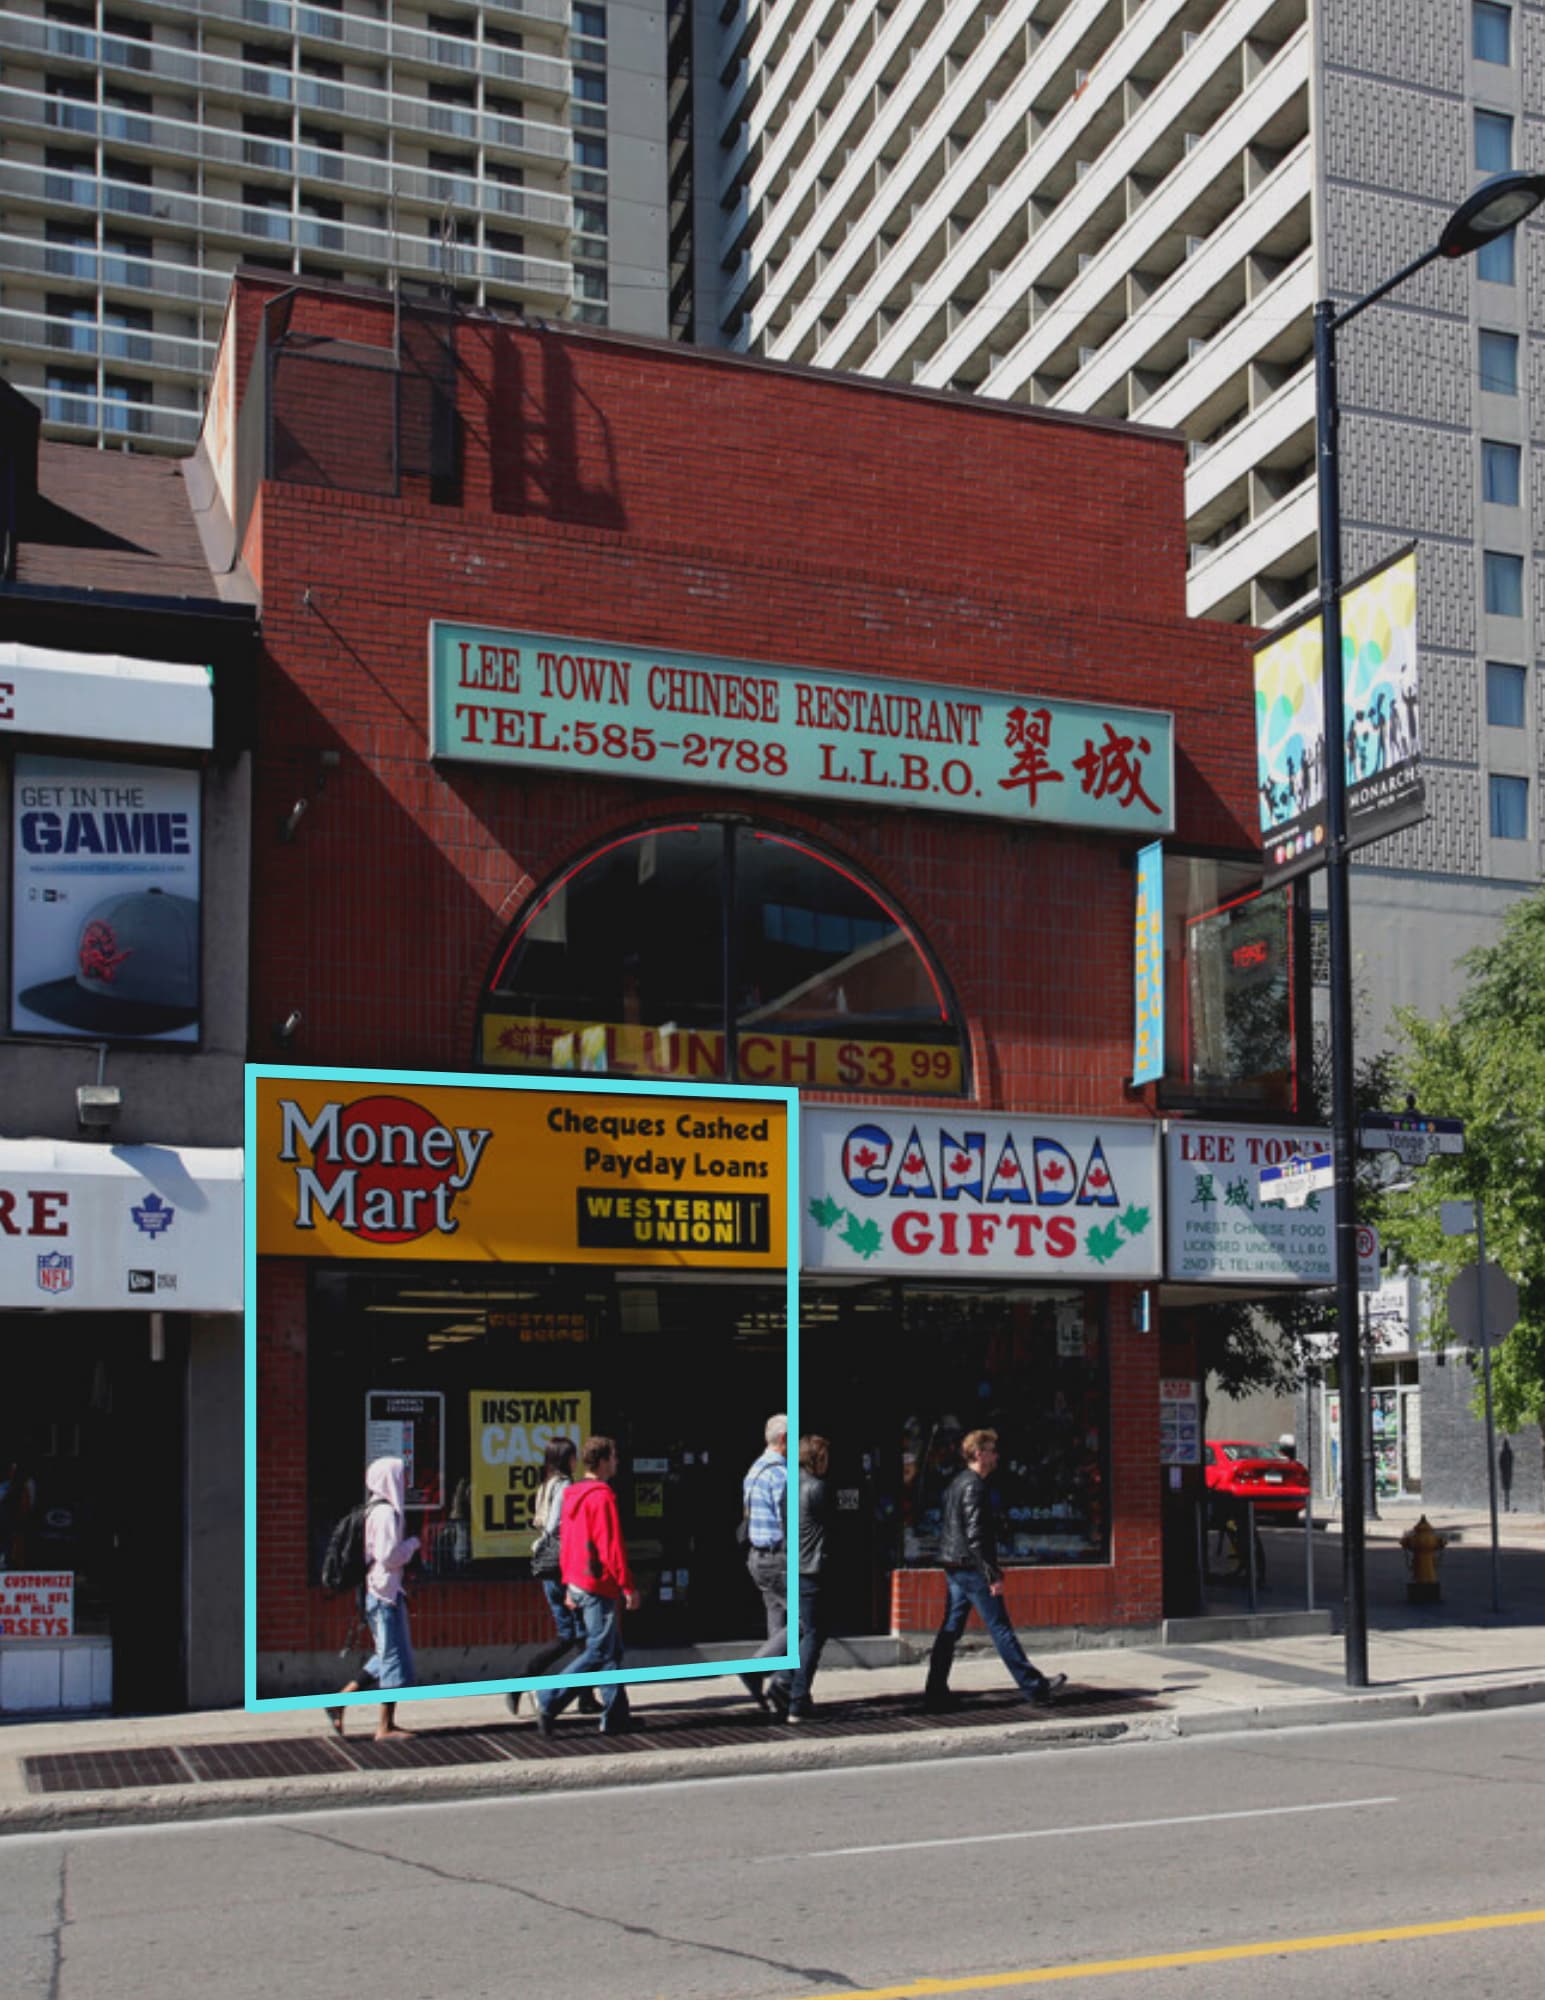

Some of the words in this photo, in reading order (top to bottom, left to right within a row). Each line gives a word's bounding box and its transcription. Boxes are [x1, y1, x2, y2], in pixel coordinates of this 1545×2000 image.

[458, 642, 520, 694] LEE
[536, 652, 632, 706] TOWN
[647, 665, 779, 724] CHINESE
[794, 683, 983, 747] RESTAURANT
[456, 704, 788, 777] TEL:585-2788
[818, 744, 982, 797] L.L.B.O.
[20, 786, 64, 808] GET
[71, 787, 96, 808] IN
[100, 788, 145, 809] THE
[1351, 763, 1422, 806] MONARCHS
[20, 811, 191, 855] GAME
[606, 1026, 817, 1083] LUNCH
[836, 1042, 953, 1088] $3.99
[547, 1107, 666, 1140] Cheques
[676, 1114, 769, 1141] Cashed
[277, 1099, 494, 1191] Money
[1180, 1133, 1235, 1164] LEE
[584, 1147, 686, 1180] Payday
[694, 1152, 769, 1178] Loans
[841, 1123, 1120, 1208] CANADA
[293, 1166, 460, 1234] Mart
[586, 1195, 734, 1221] WESTERN
[634, 1220, 734, 1244] UNION
[891, 1210, 1078, 1259] GIFTS
[1186, 1221, 1228, 1235] FINEST
[1233, 1221, 1285, 1237] CHINESE
[1290, 1223, 1326, 1238] FOOD
[1183, 1239, 1241, 1253] LICENSED
[1246, 1241, 1286, 1255] UNDER
[40, 1268, 70, 1290] NFL
[1183, 1256, 1208, 1271] 2ND
[482, 1398, 580, 1424] INSTANT
[509, 1466, 544, 1490] FO
[4, 1575, 72, 1589] CUSTOMIZE
